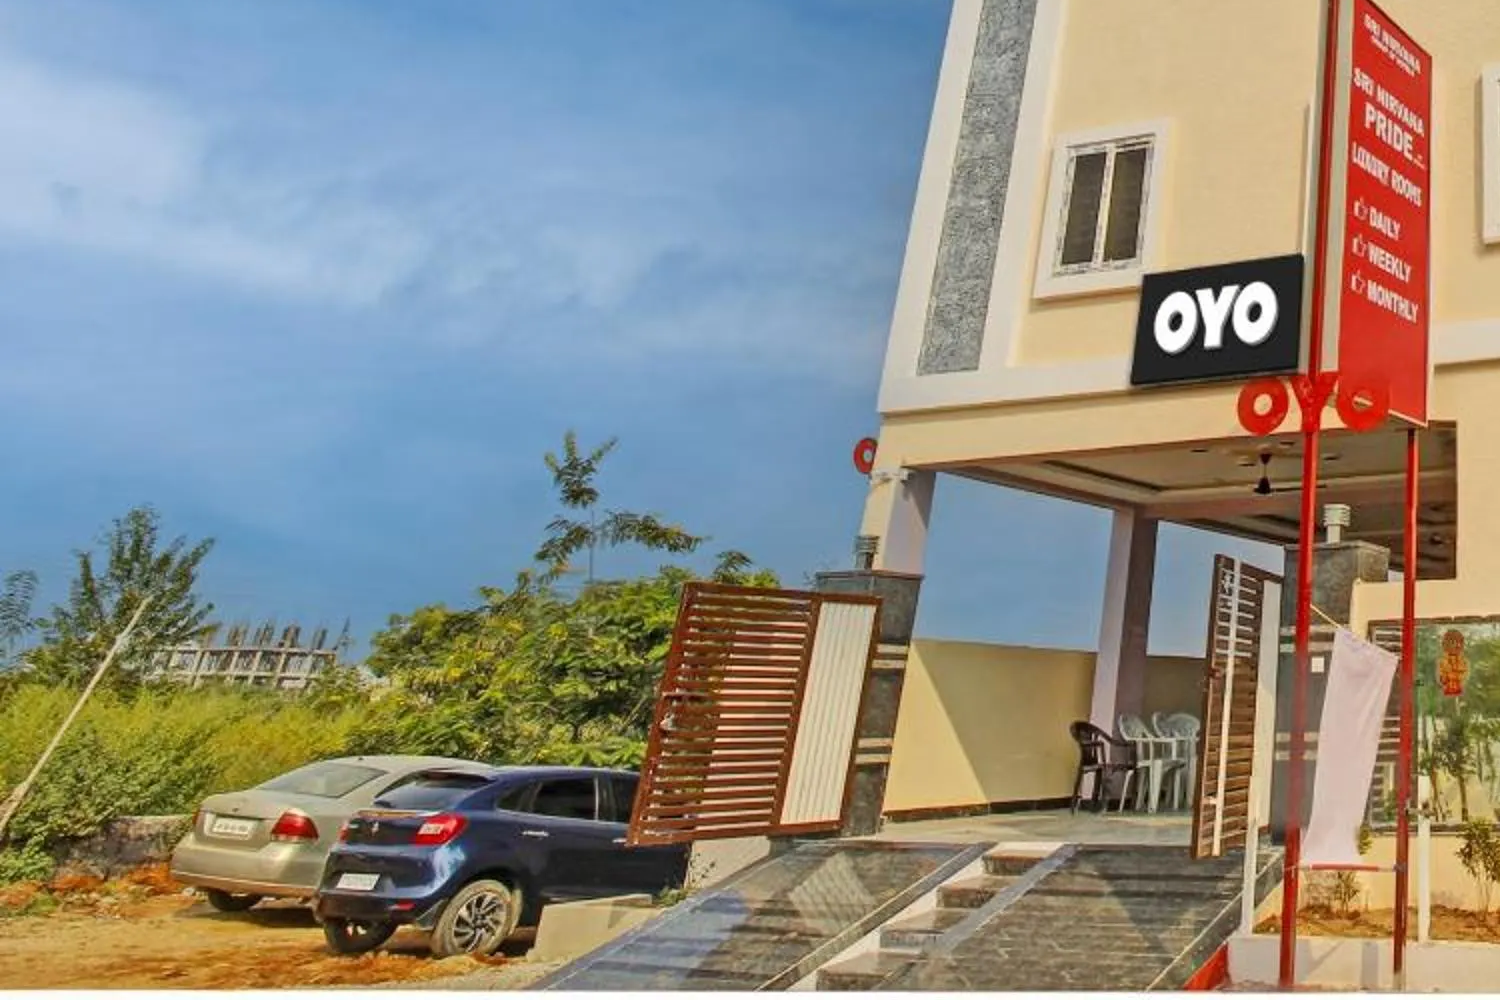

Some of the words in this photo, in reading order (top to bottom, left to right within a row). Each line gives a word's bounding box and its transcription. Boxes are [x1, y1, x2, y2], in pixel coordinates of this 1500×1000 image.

[1353, 67, 1375, 96] SRI
[1376, 83, 1424, 137] NIRVANA
[1364, 101, 1413, 161] PRIDE
[1352, 141, 1391, 187] LUXURY
[1391, 168, 1422, 207] ROOMS
[1369, 205, 1401, 240] DAILY
[1367, 241, 1412, 283] WEEKLY
[1153, 280, 1279, 355] OYO
[1367, 279, 1419, 323] MONTHLY
[1237, 374, 1390, 435] OYO
